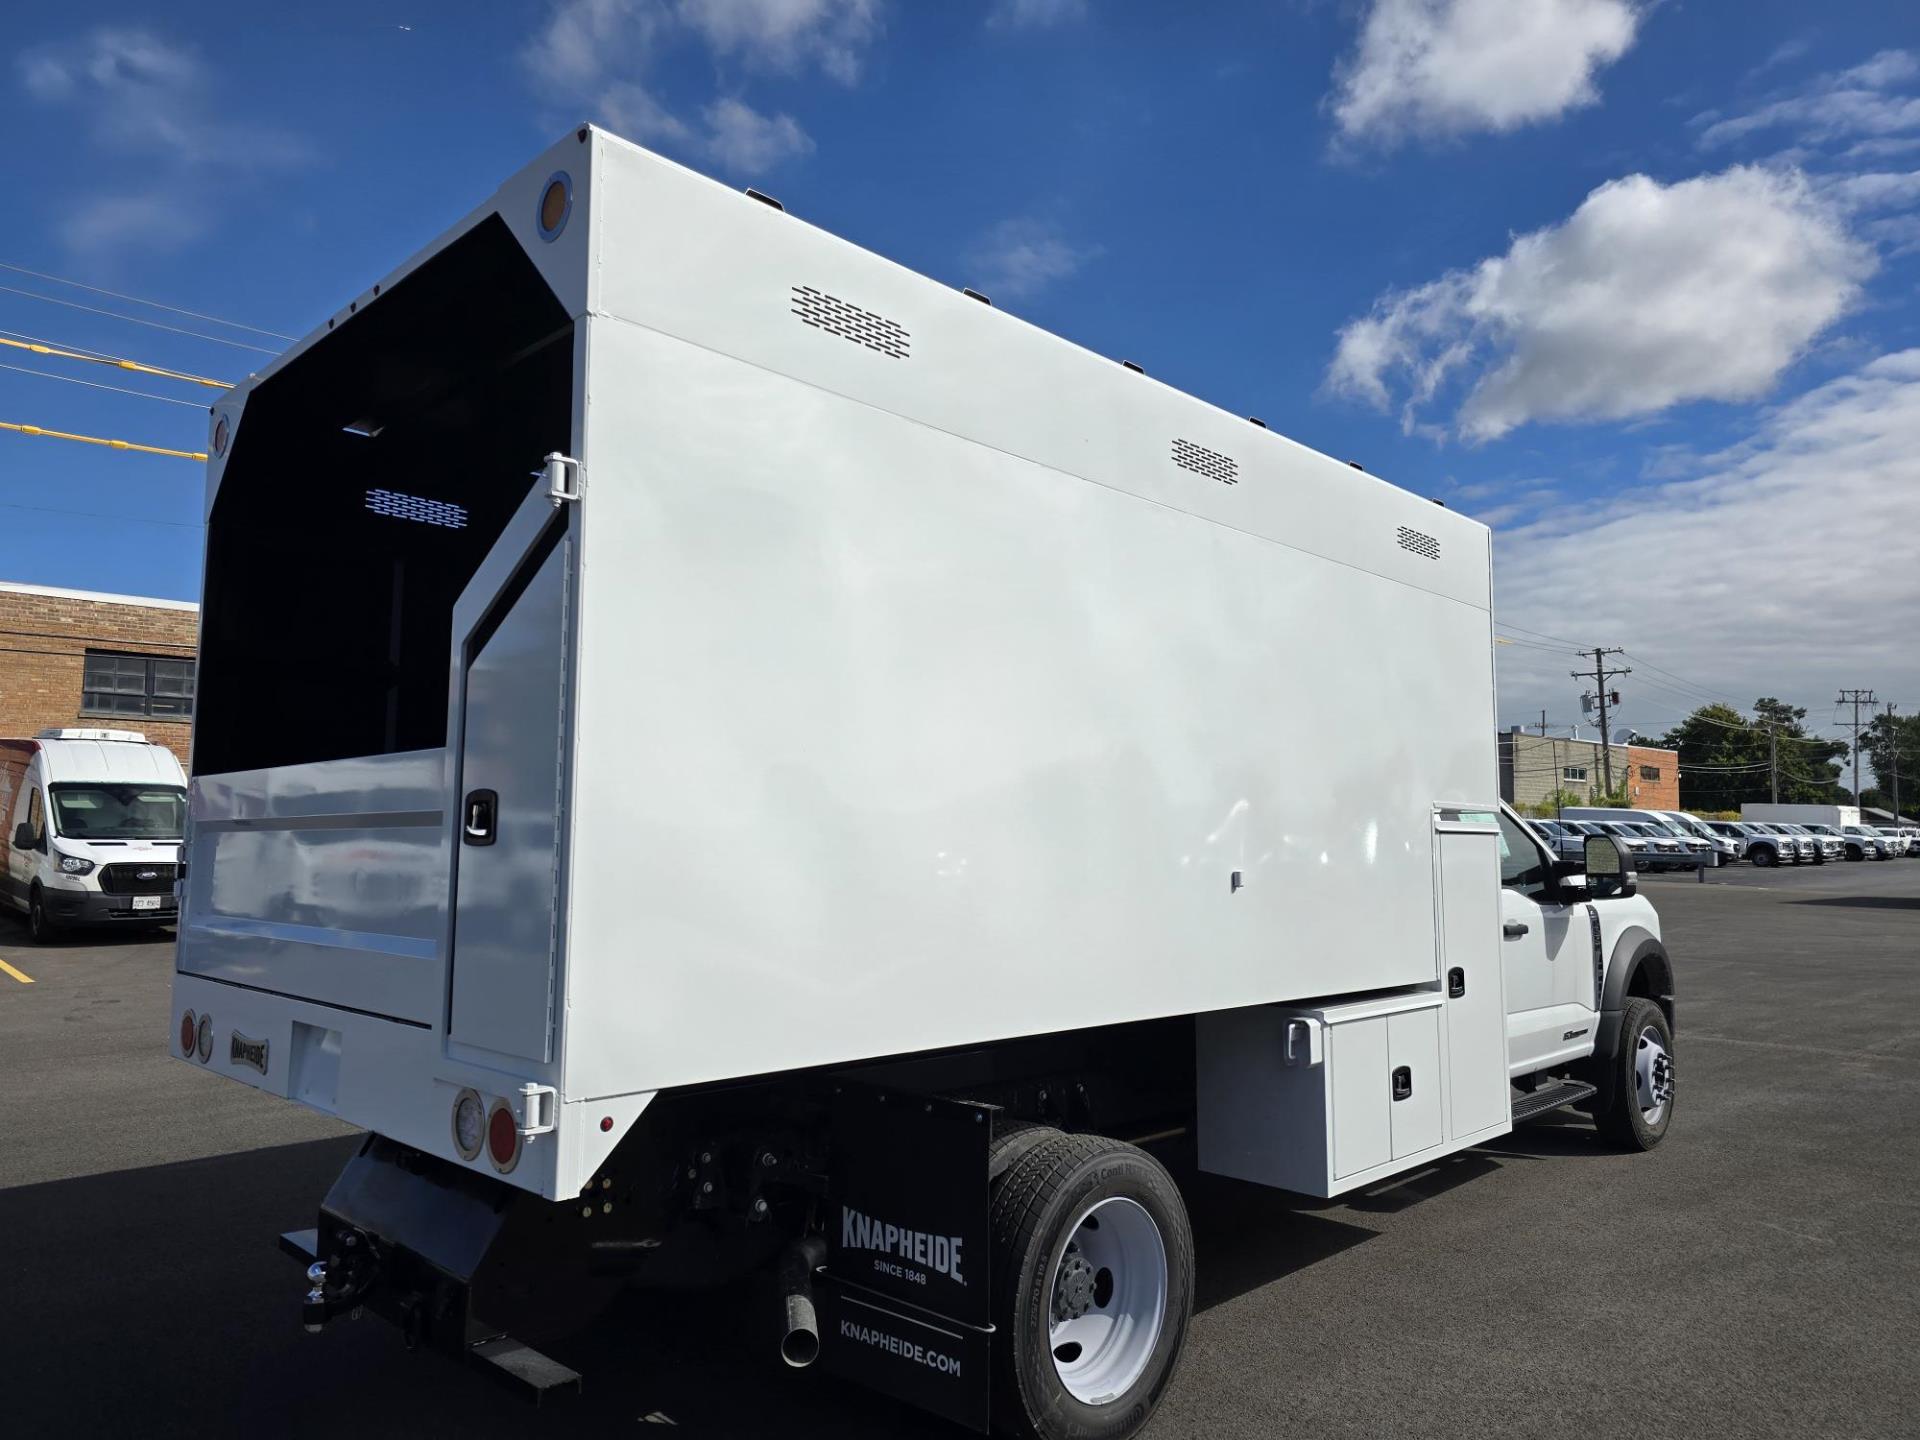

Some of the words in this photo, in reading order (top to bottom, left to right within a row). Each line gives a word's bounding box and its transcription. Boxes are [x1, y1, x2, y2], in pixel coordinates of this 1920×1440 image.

[842, 1205, 963, 1286] KNAPHEIDE
[873, 1259, 903, 1278] SINCE
[904, 1268, 927, 1286] 1848
[841, 1319, 961, 1378] KNAPHEIDE.COM
